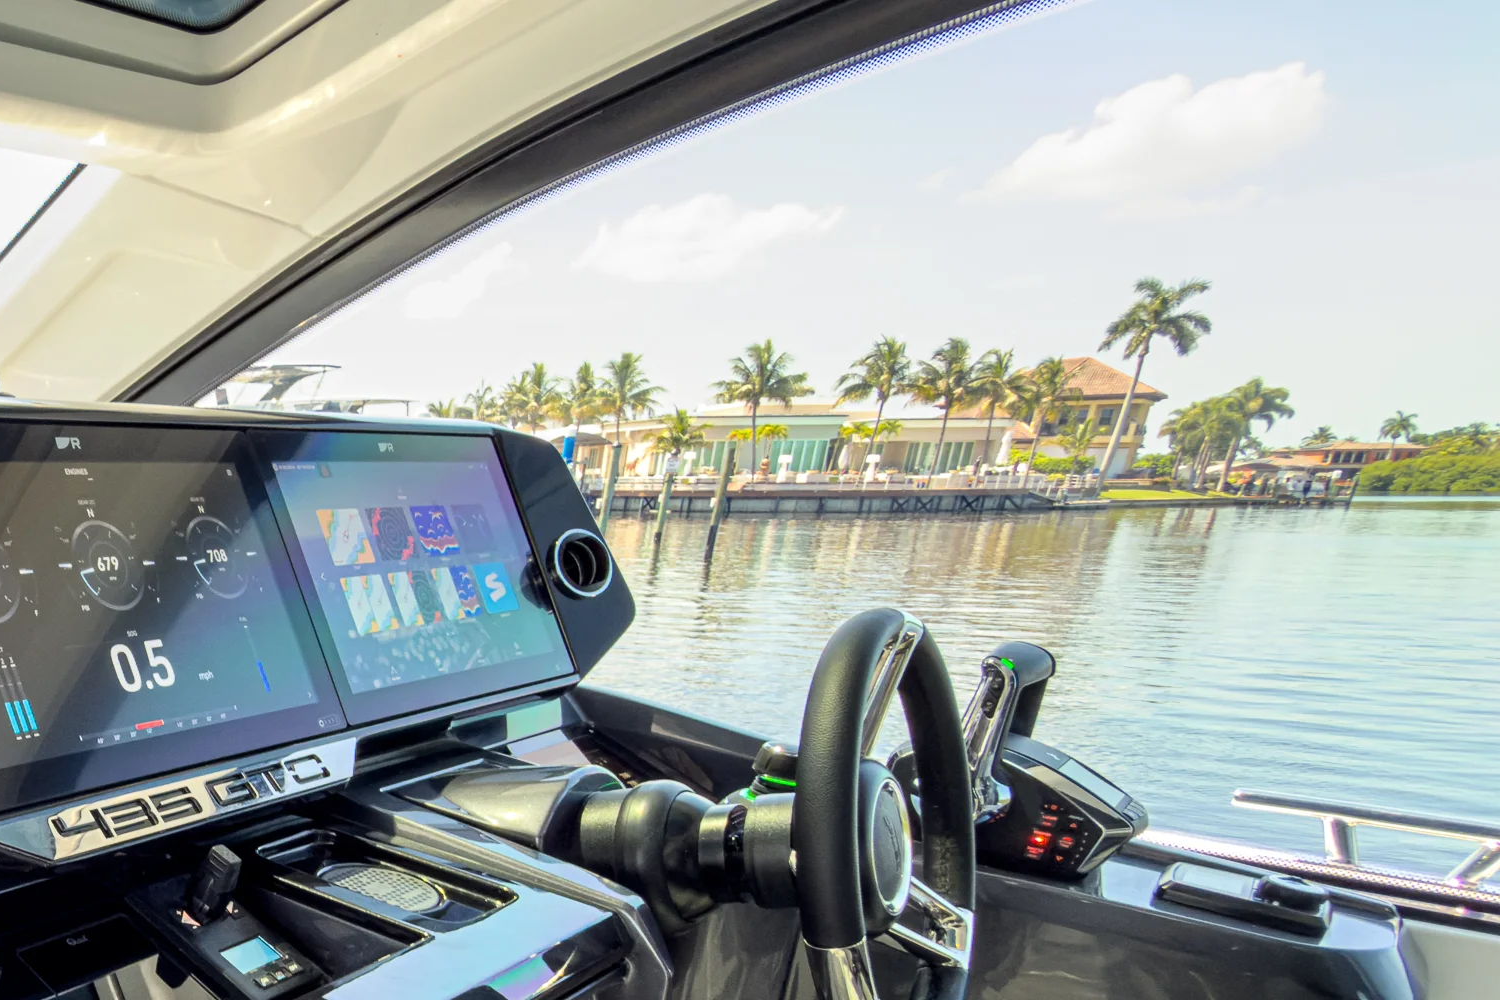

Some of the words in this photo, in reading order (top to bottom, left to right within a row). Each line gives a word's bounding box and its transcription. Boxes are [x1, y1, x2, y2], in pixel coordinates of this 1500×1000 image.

[97, 556, 119, 572] 679
[206, 549, 228, 563] 708
[110, 638, 176, 693] 0.5
[198, 670, 215, 682] mph
[48, 786, 204, 839] 435
